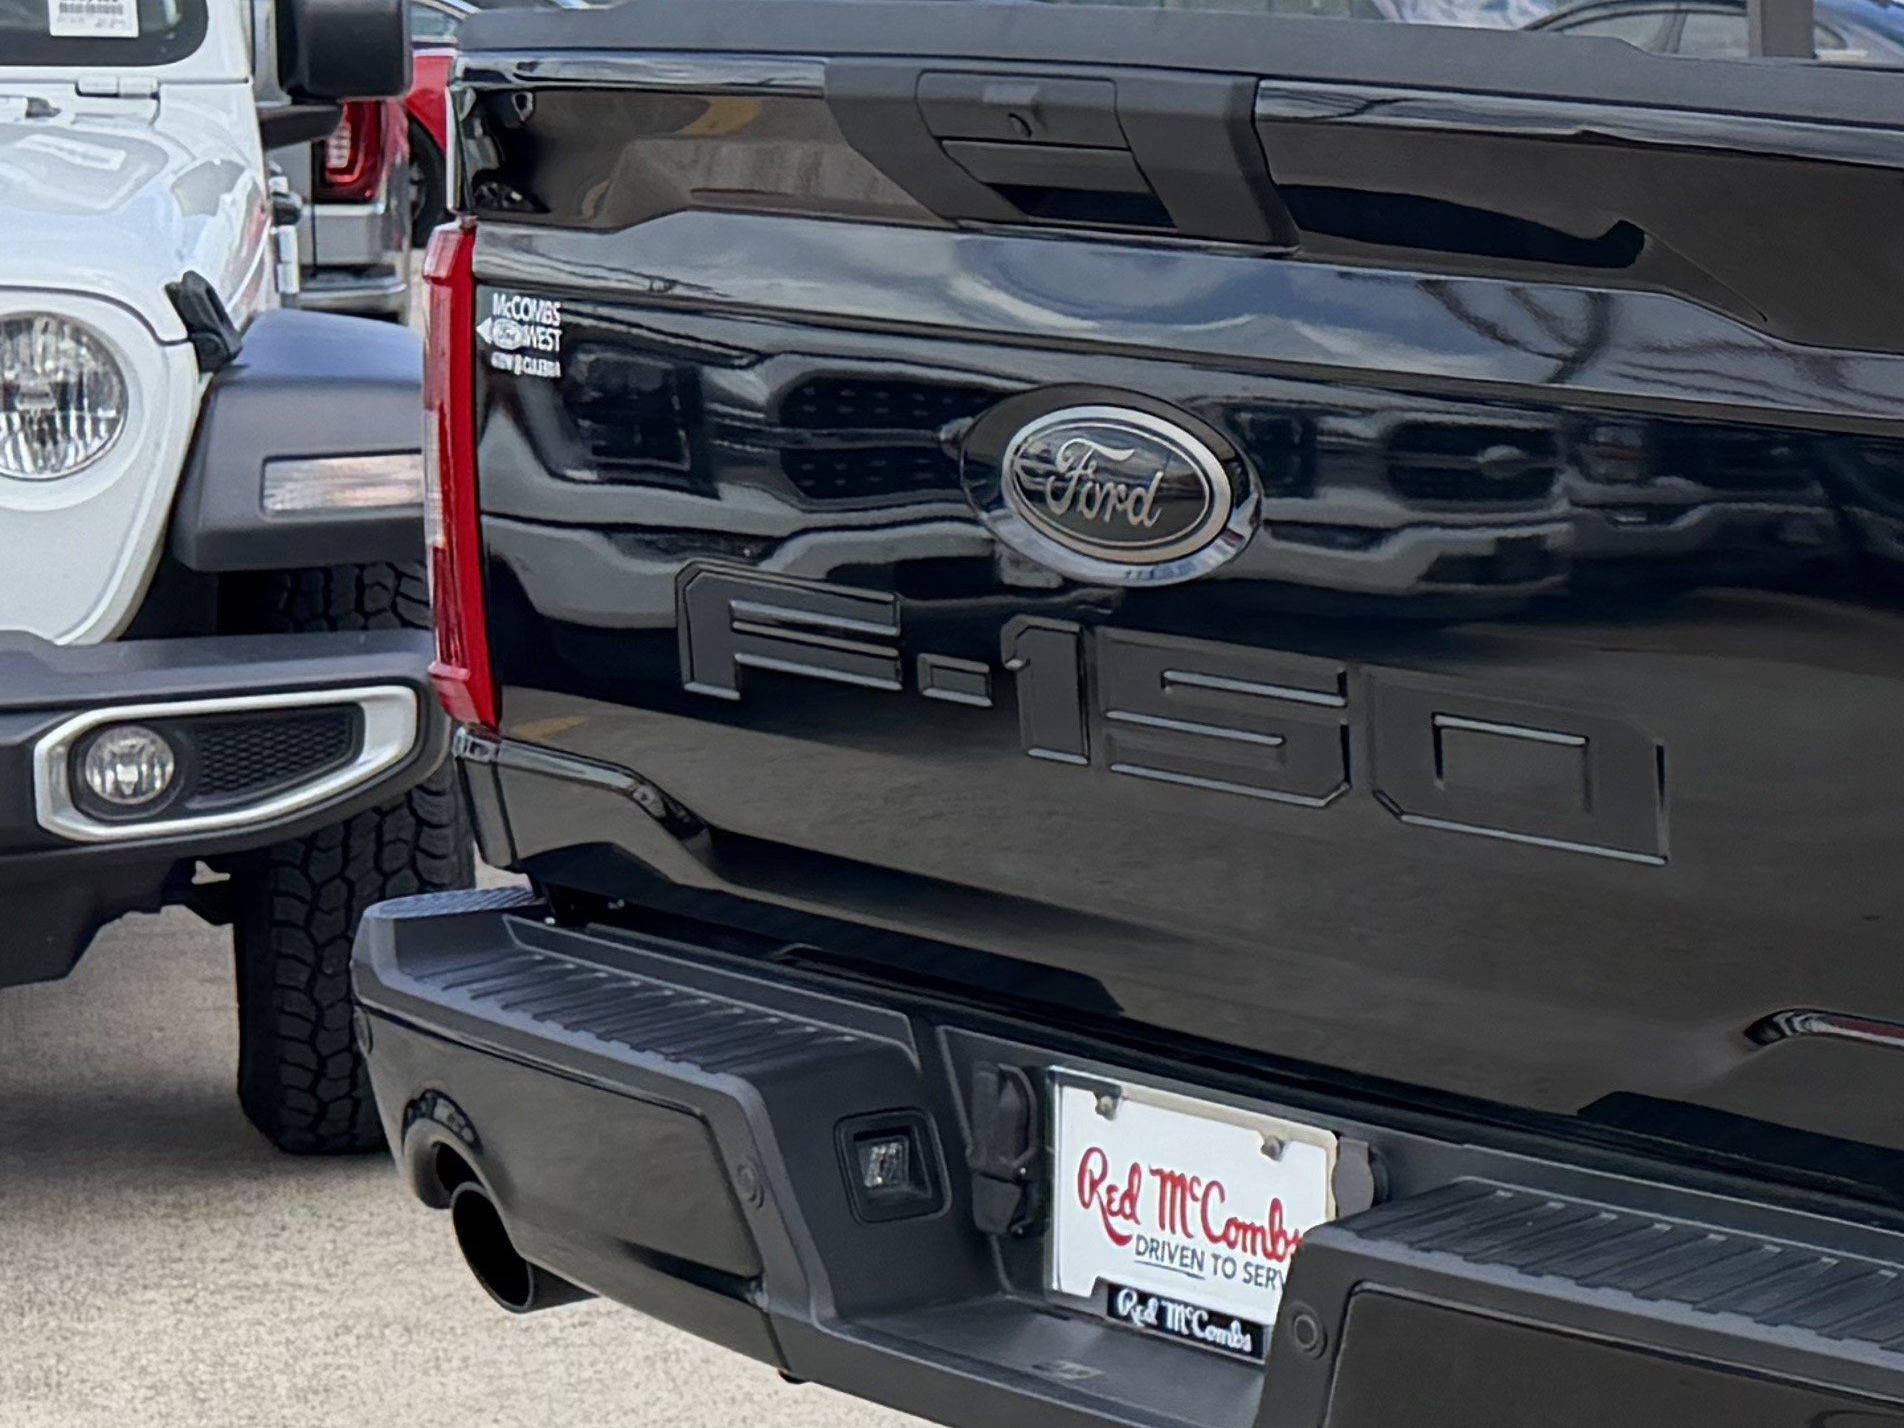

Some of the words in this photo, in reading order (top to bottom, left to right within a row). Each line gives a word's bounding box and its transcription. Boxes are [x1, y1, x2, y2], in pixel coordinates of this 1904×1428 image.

[492, 292, 561, 327] McCOMBS
[520, 323, 562, 353] WEST
[1046, 438, 1164, 528] Ford
[676, 561, 1670, 865] F-150
[1077, 1146, 1141, 1247] Red
[1134, 1234, 1206, 1273] DRIVEN
[1211, 1253, 1238, 1280] TO
[1116, 1288, 1159, 1328] Red
[1160, 1300, 1253, 1353] McCombs
